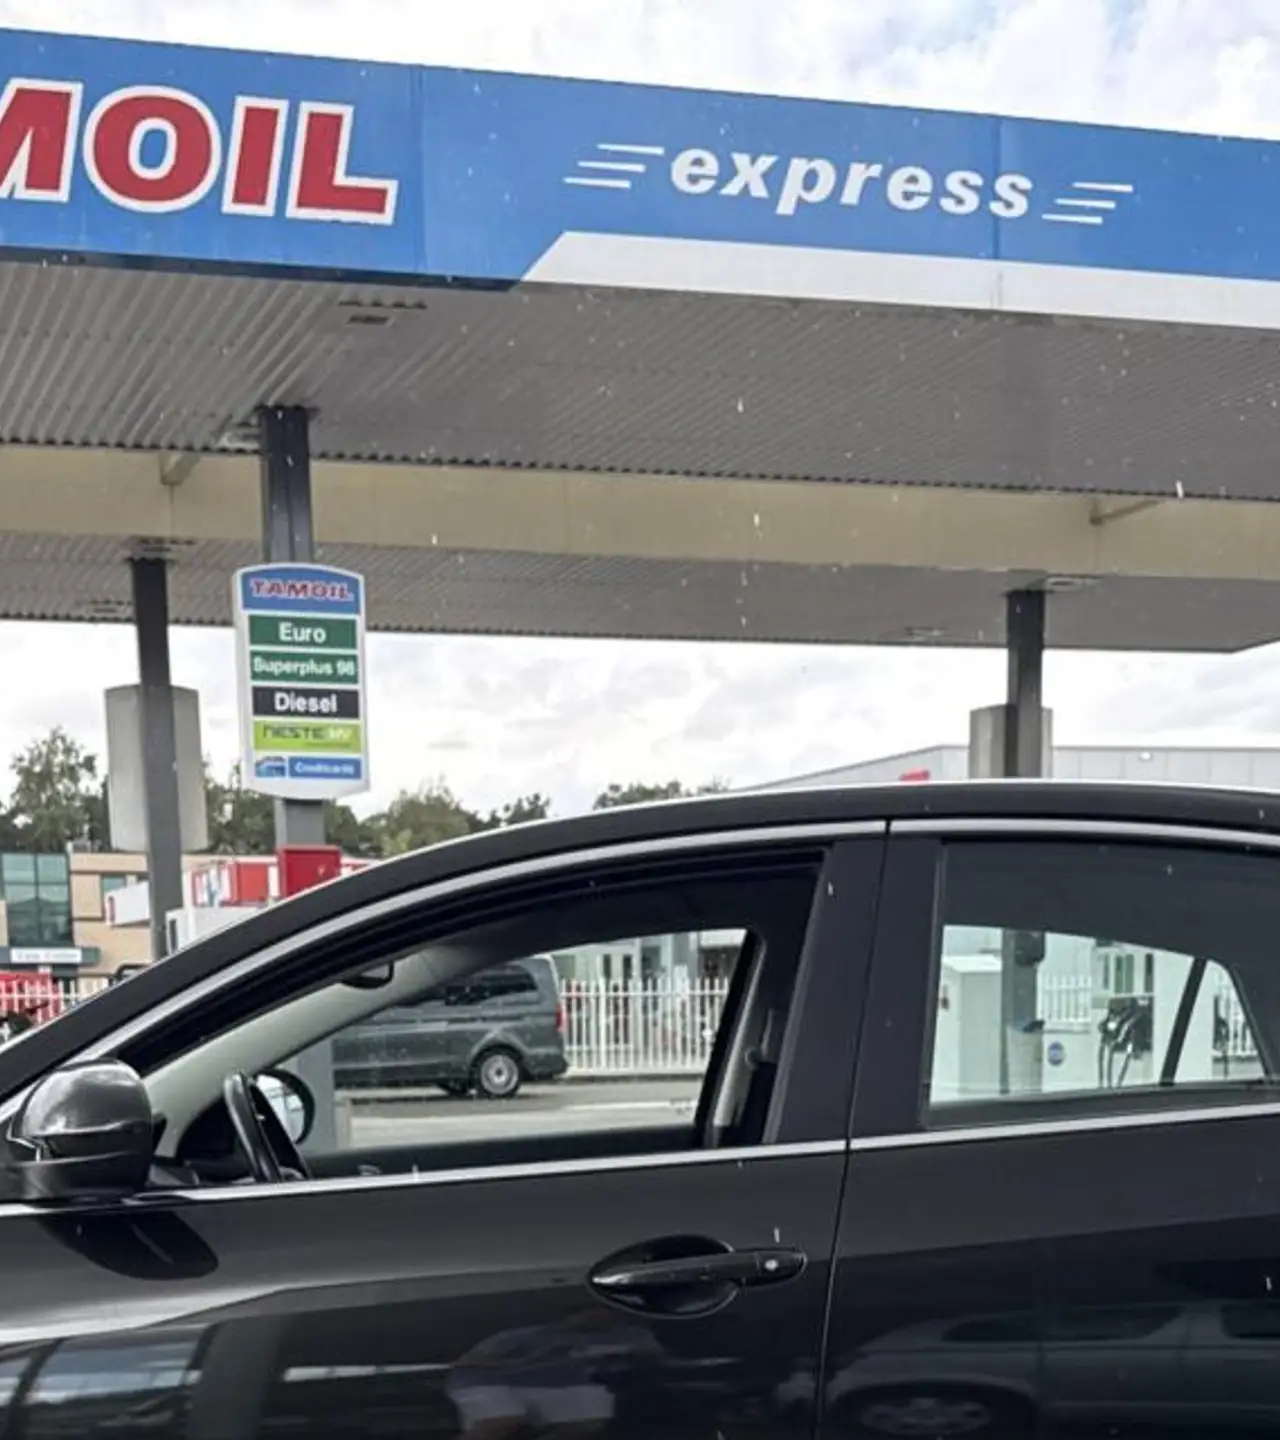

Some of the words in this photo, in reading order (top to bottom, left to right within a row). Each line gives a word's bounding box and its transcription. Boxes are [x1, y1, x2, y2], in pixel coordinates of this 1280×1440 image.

[670, 146, 1033, 218] express
[250, 579, 354, 602] TAMOIL
[278, 622, 327, 644] Euro
[253, 656, 333, 677] Superplus
[274, 692, 337, 713] Diesel
